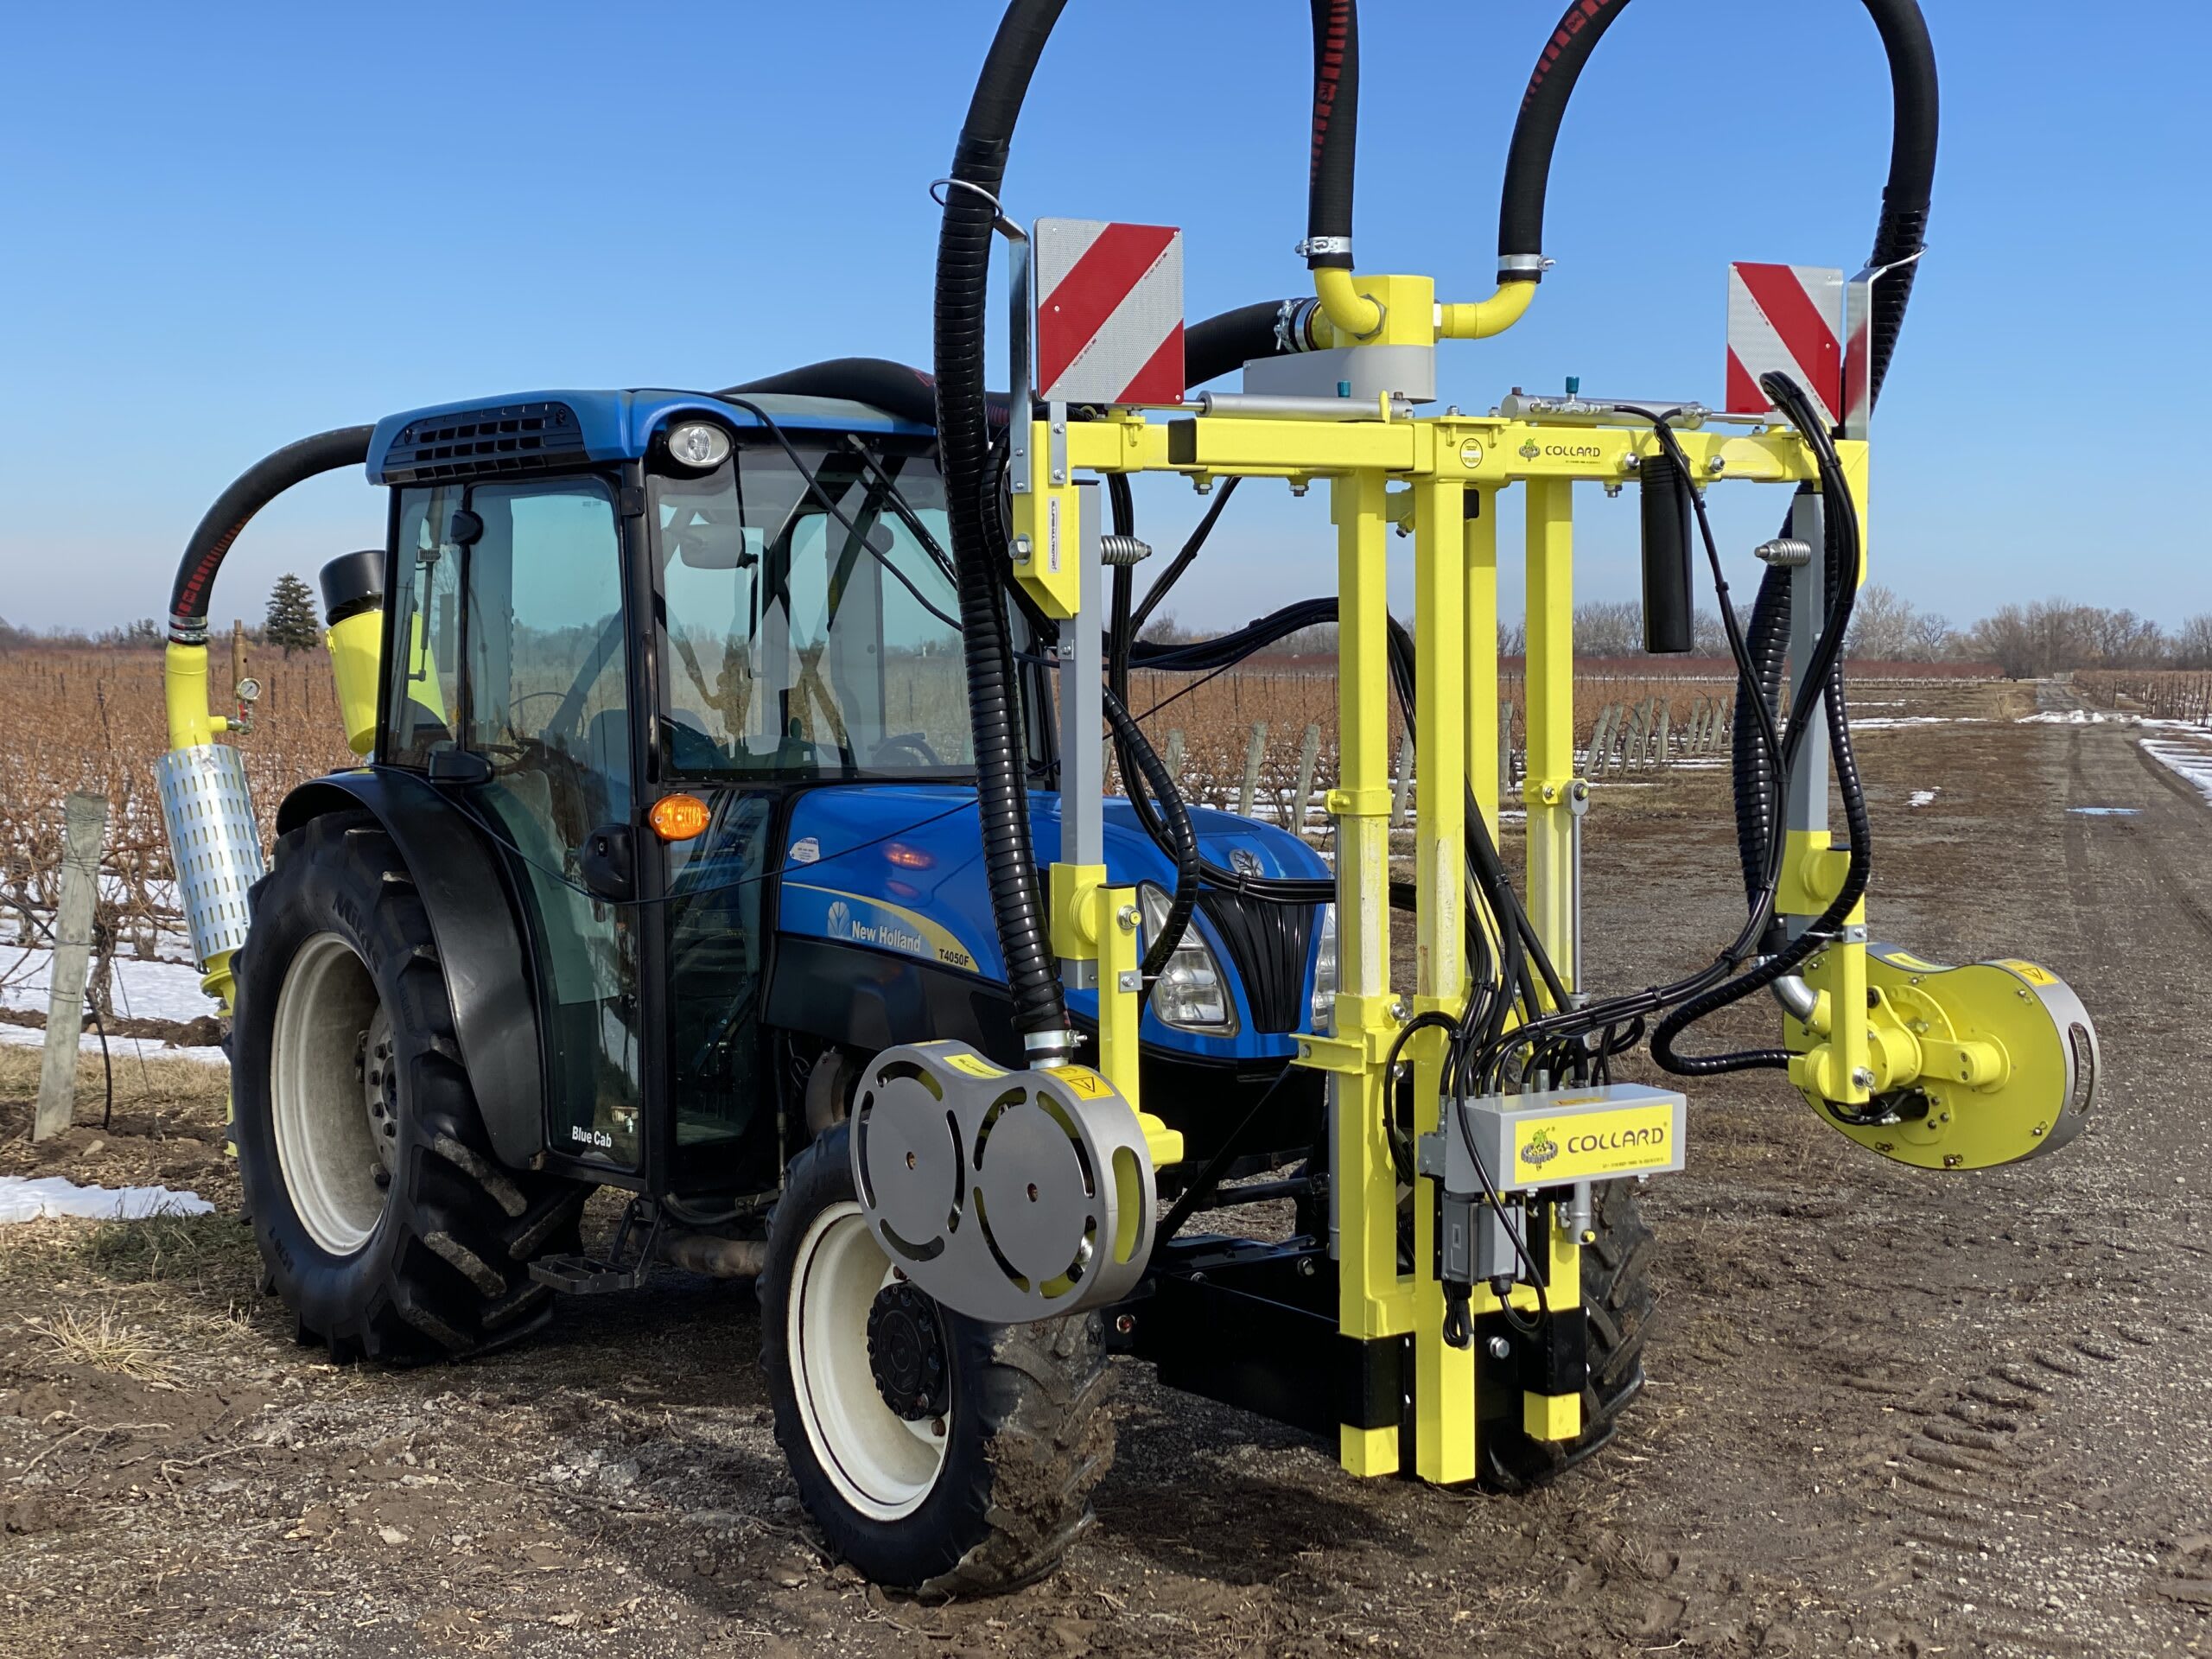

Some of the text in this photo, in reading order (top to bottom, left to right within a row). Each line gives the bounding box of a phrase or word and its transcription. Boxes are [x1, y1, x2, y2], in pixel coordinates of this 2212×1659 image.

[1546, 445, 1601, 457] COLLARD
[852, 920, 921, 953] New Holland
[939, 949, 969, 966] T4050F
[572, 1125, 613, 1148] Blue Cab
[1567, 1127, 1664, 1154] COLLARD
